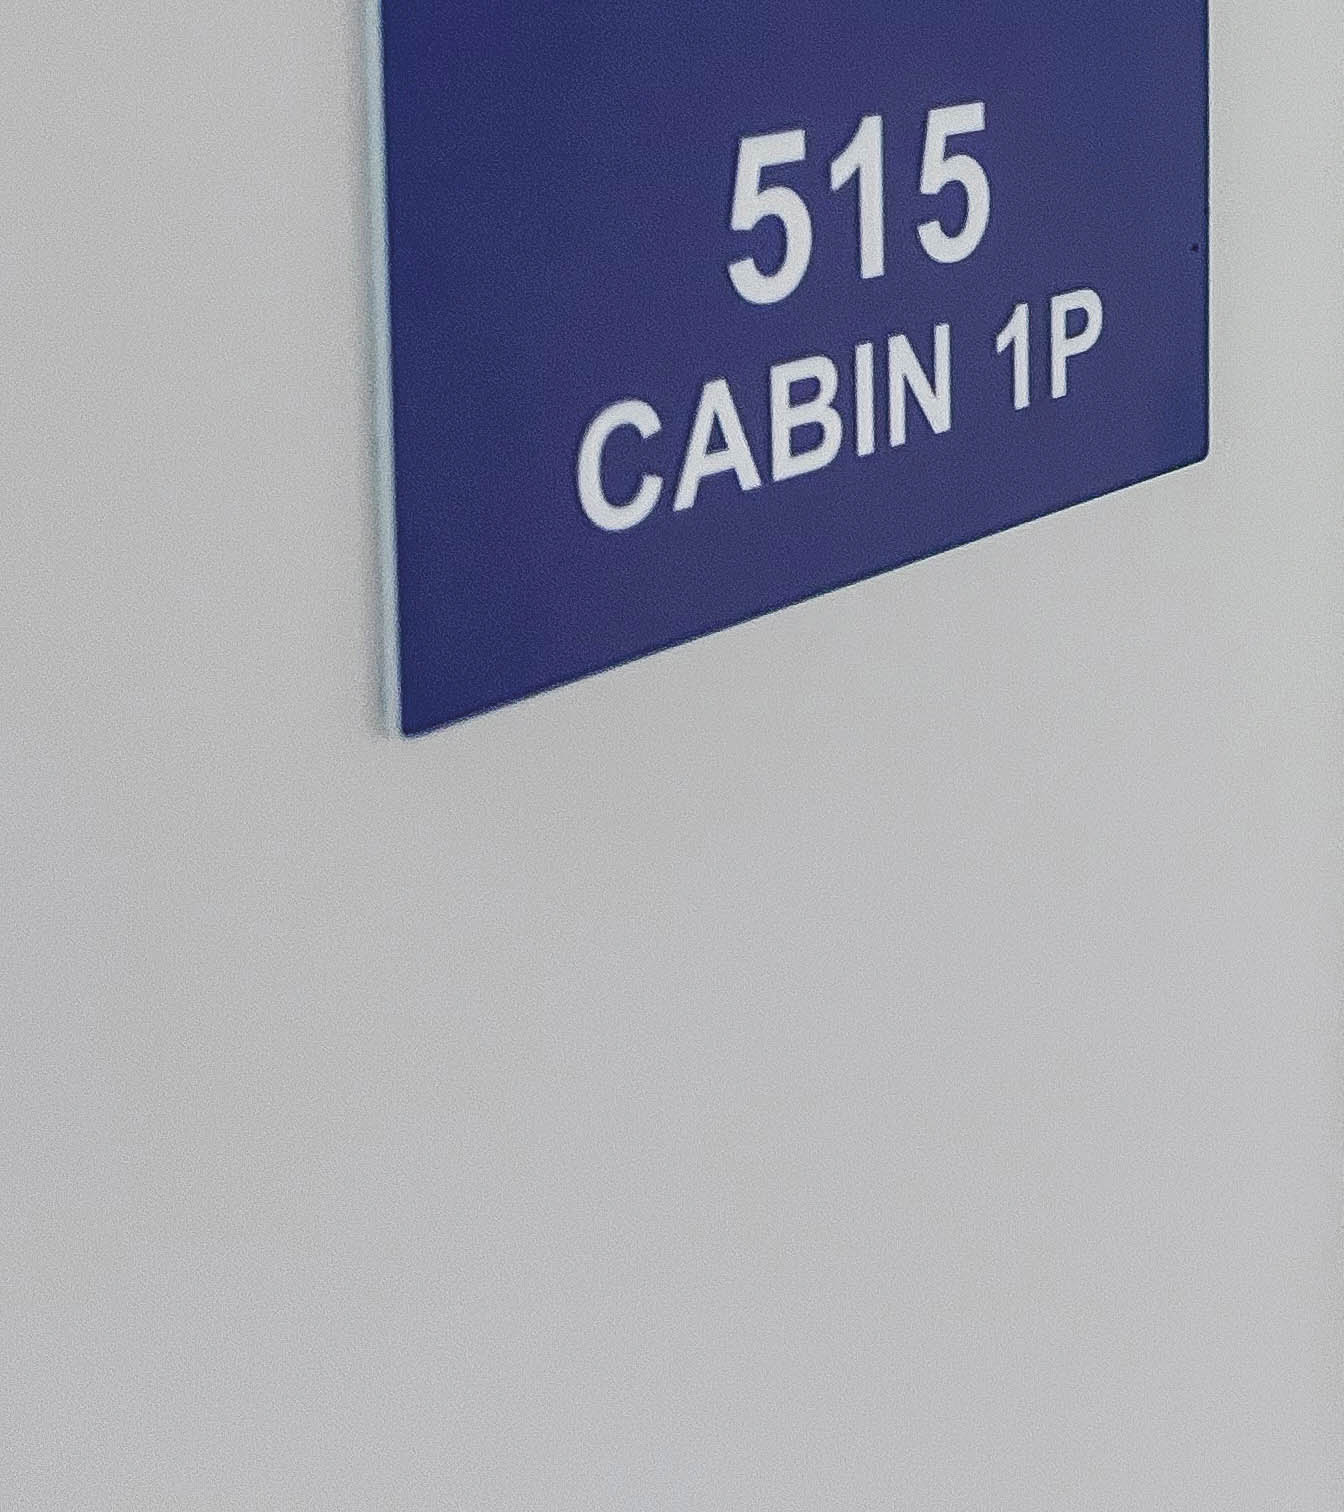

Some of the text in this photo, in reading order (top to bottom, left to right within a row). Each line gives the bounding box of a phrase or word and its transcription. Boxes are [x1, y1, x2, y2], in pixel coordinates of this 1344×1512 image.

[728, 101, 990, 304] 515
[577, 289, 1103, 531] CABIN 1P
